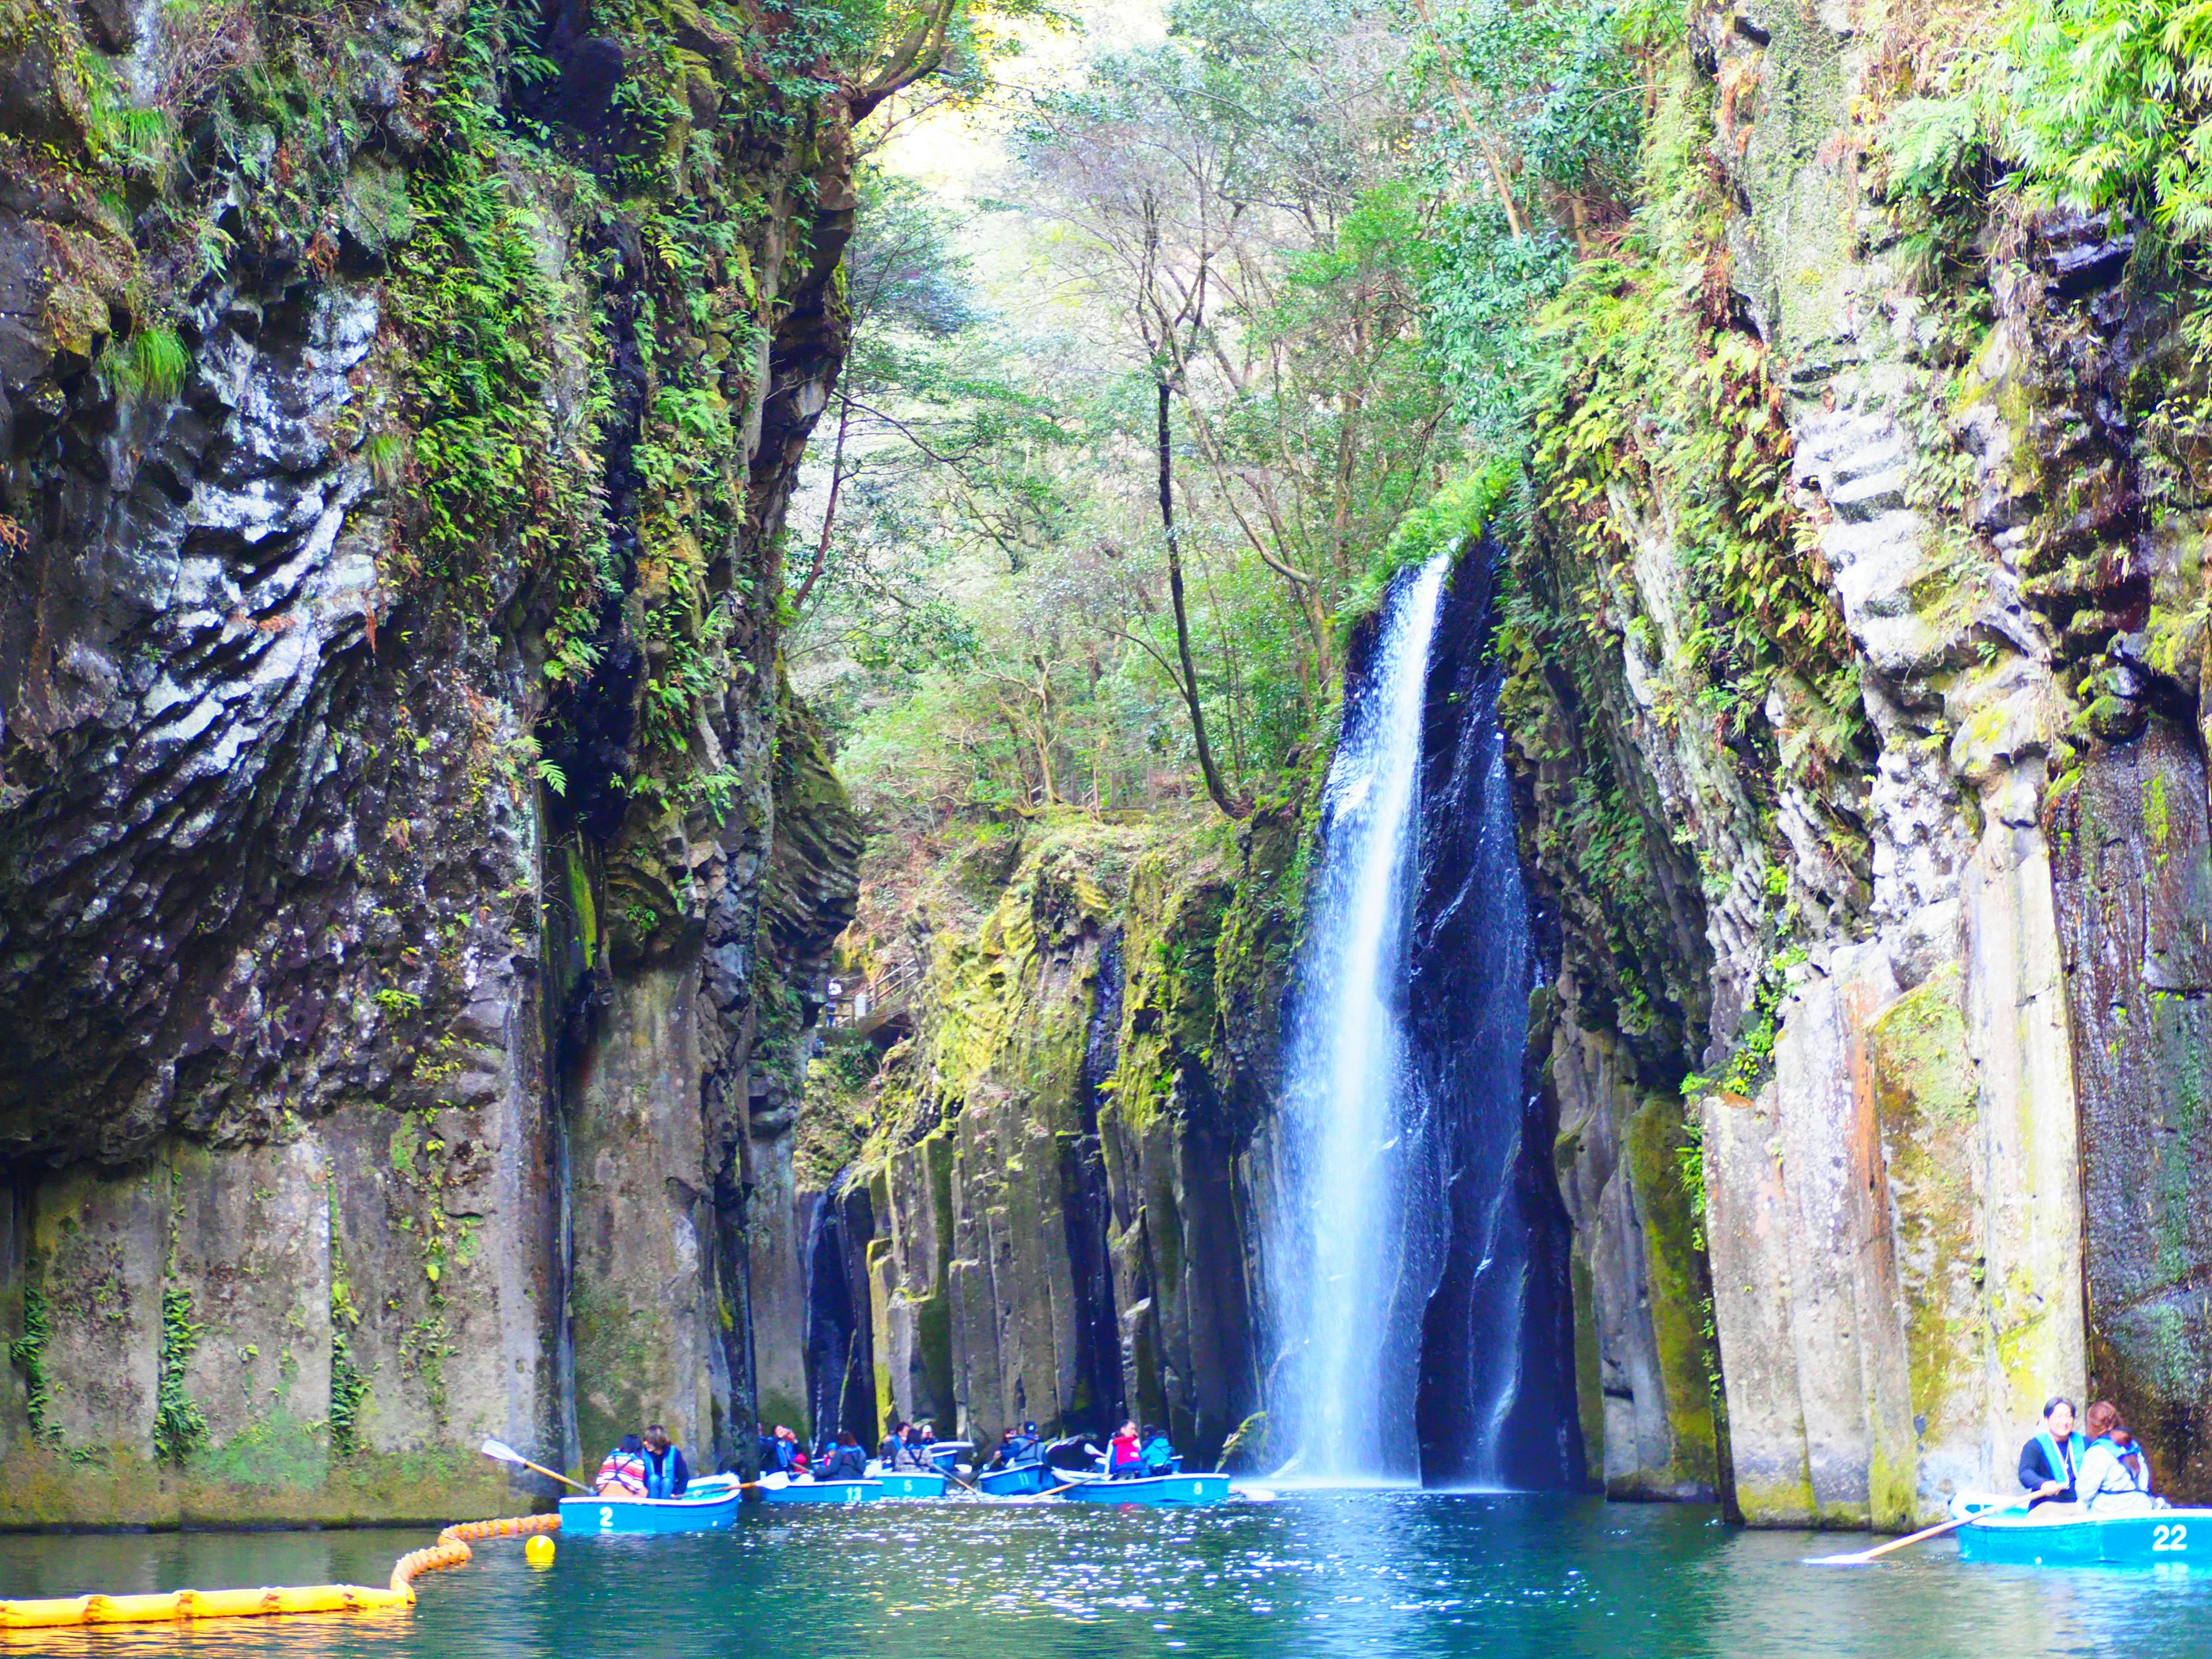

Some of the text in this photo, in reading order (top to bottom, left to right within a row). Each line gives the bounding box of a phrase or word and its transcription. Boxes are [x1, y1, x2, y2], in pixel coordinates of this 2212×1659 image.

[846, 1486, 862, 1501] 13
[904, 1480, 912, 1492] 5
[1194, 1482, 1202, 1495] 8
[600, 1506, 613, 1527] 2
[2152, 1524, 2187, 1551] 22
